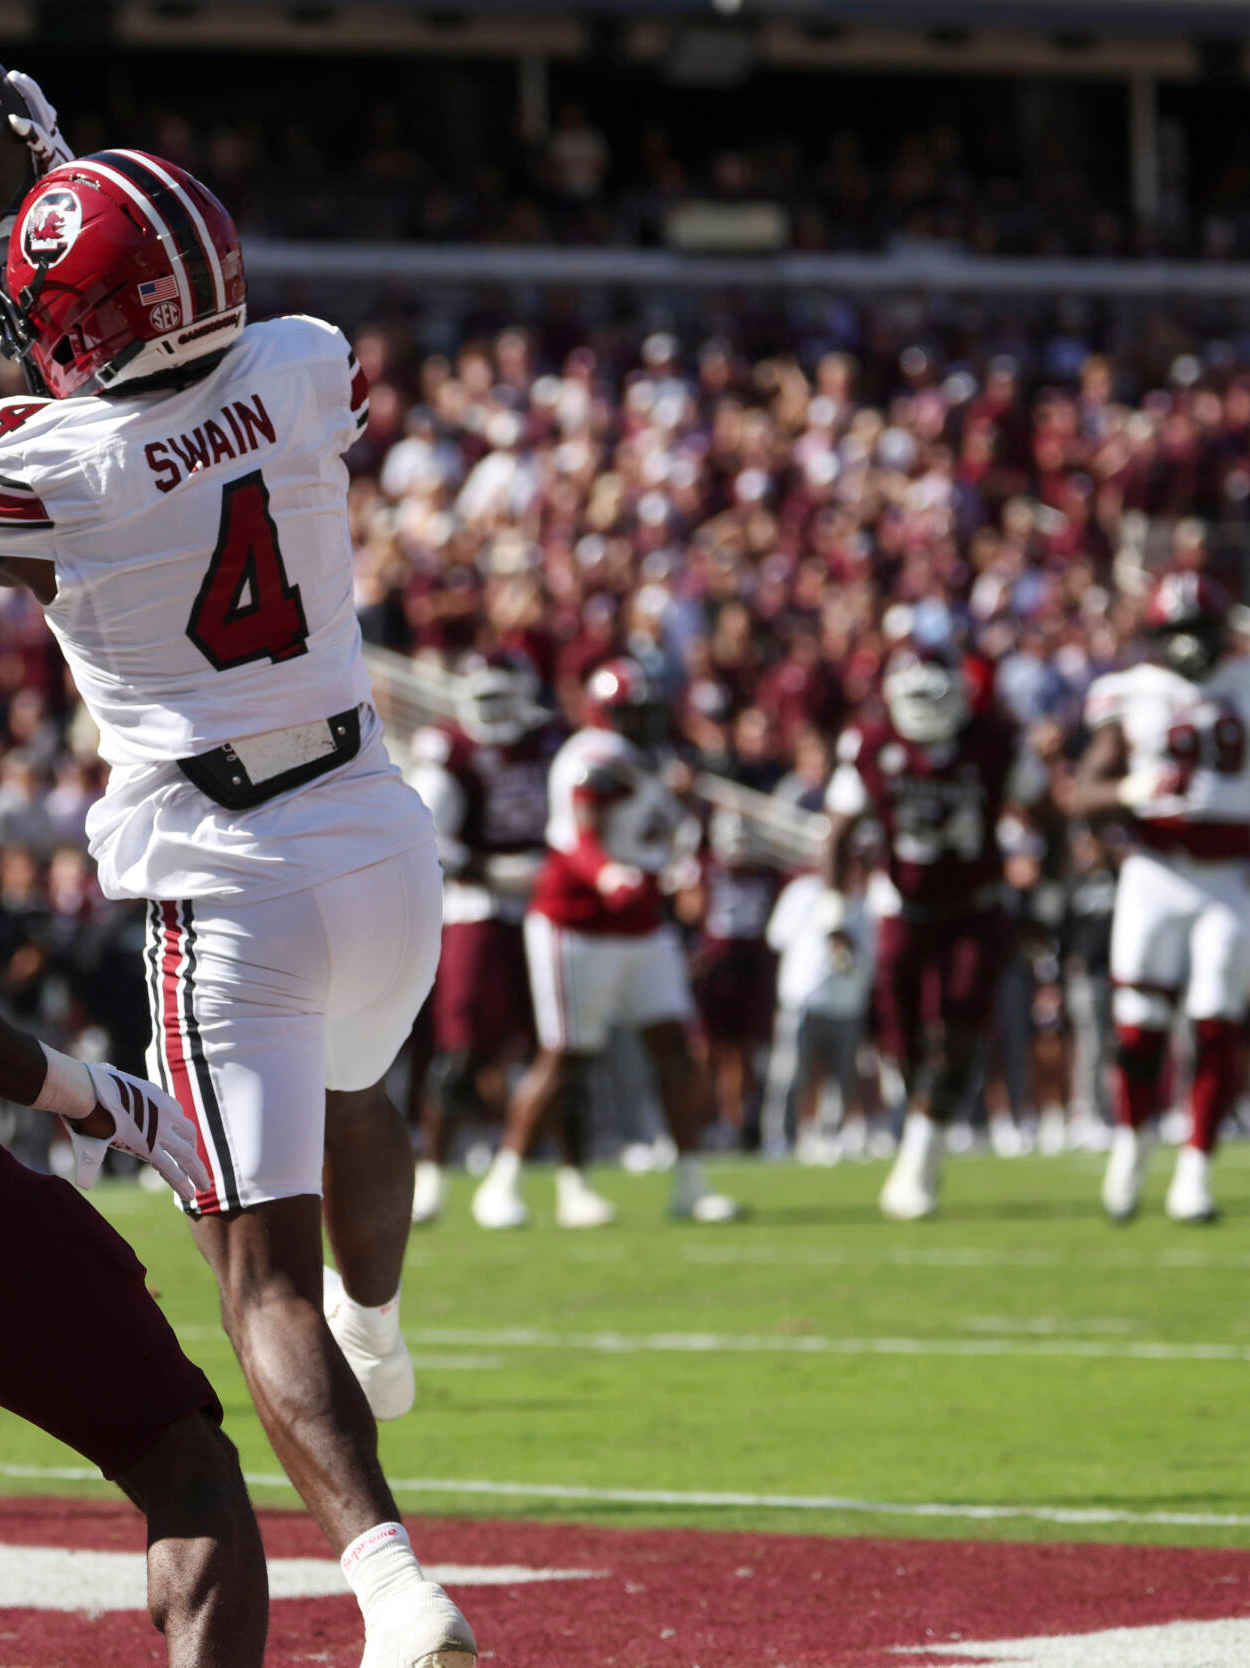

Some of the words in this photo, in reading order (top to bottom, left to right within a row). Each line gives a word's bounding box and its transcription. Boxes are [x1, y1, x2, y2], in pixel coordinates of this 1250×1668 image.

[151, 303, 181, 331] SEC
[144, 394, 277, 493] SWAIN
[185, 469, 310, 672] 4
